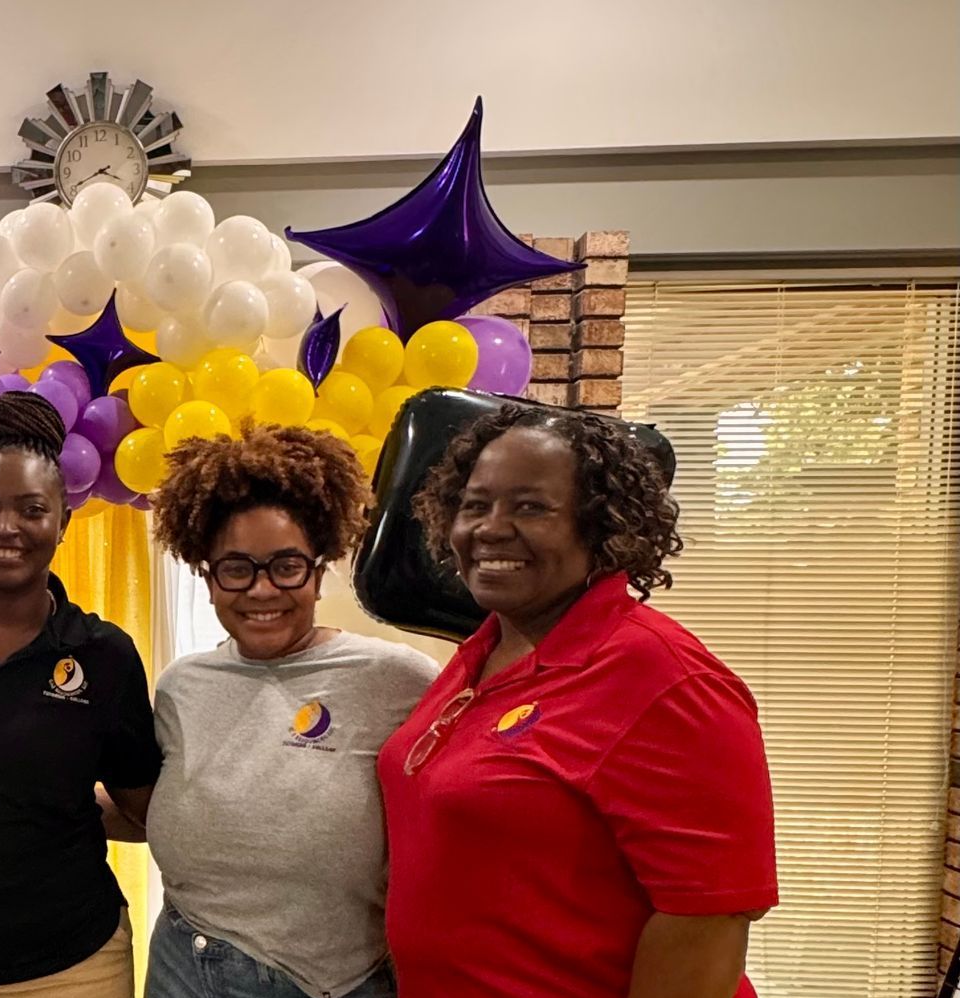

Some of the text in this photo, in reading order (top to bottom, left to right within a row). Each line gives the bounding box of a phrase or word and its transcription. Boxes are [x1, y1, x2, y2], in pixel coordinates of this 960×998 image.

[79, 135, 88, 148] 11
[94, 129, 107, 142] 12
[67, 149, 82, 163] 10
[126, 146, 135, 159] 2
[63, 166, 71, 179] 9
[133, 162, 140, 175] 3
